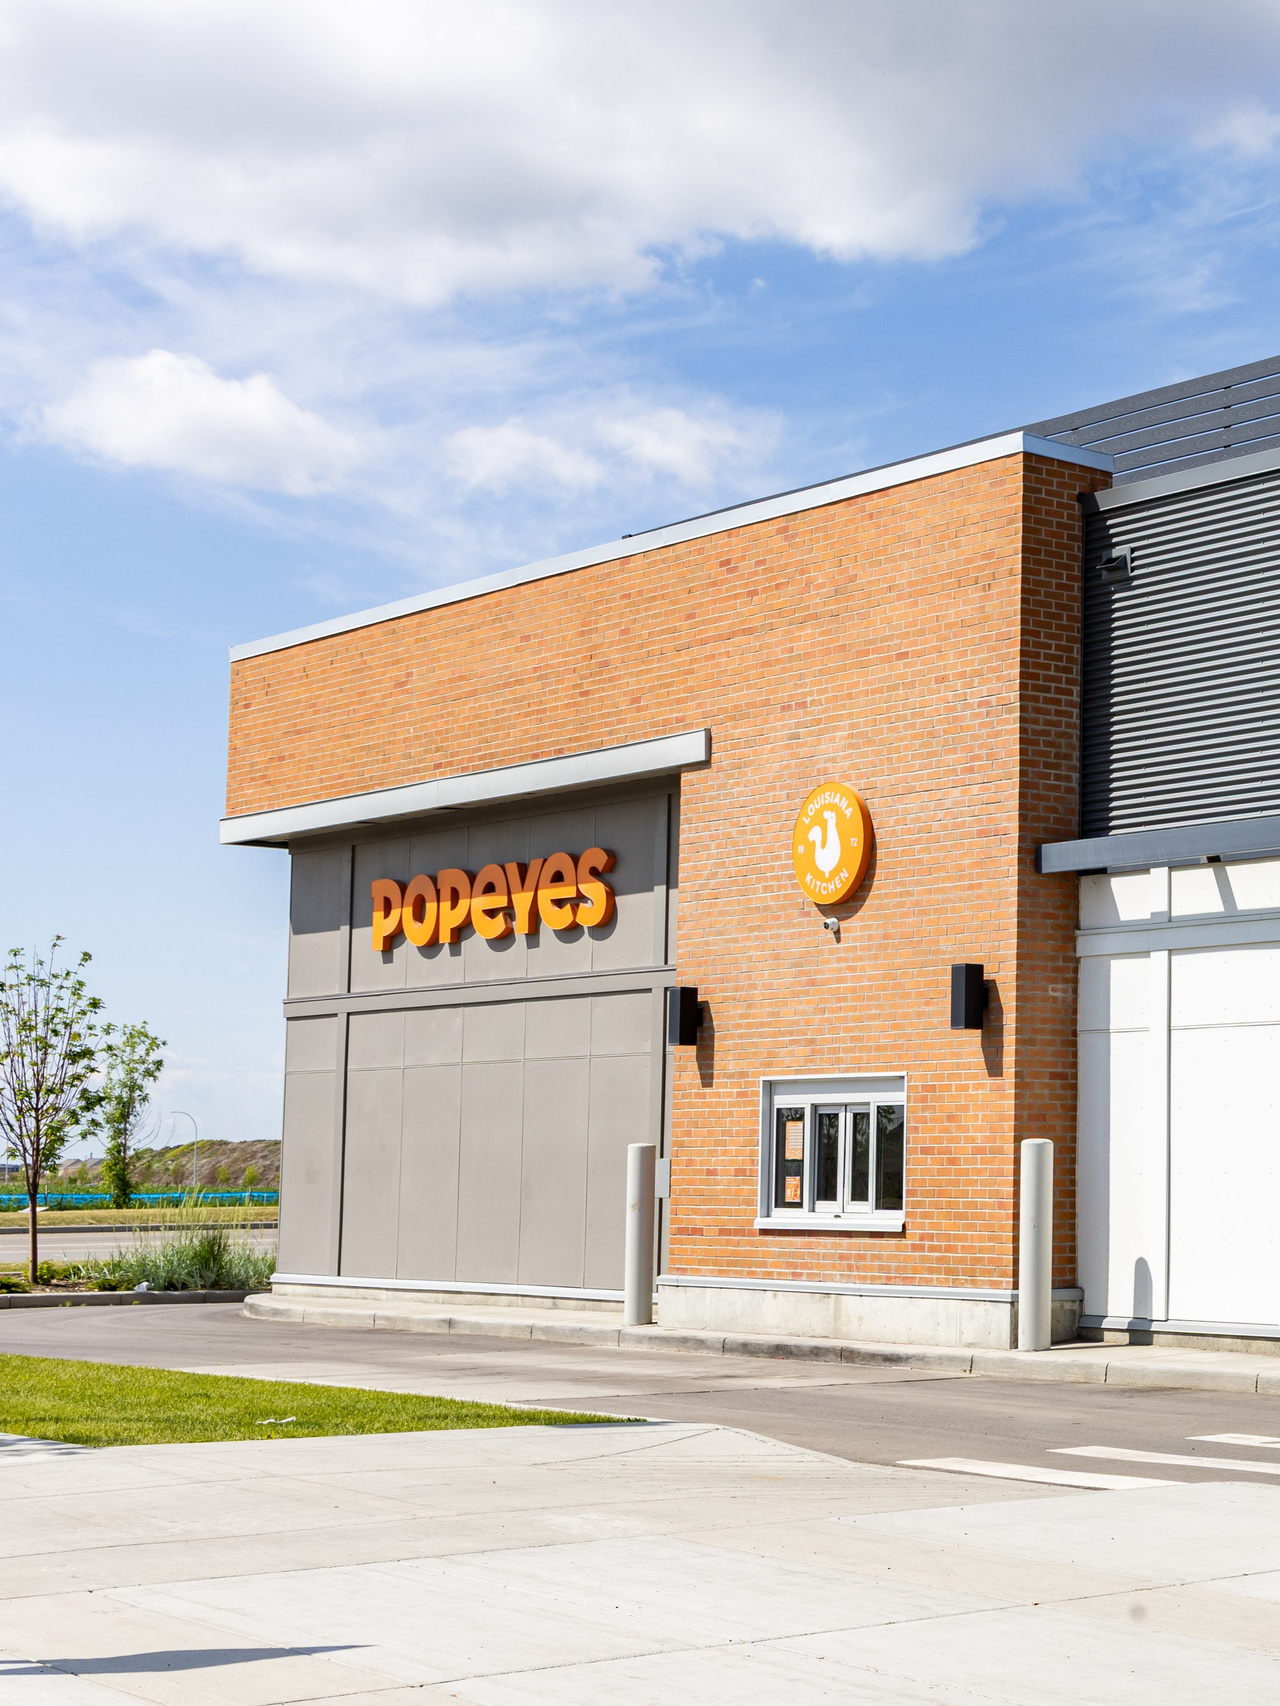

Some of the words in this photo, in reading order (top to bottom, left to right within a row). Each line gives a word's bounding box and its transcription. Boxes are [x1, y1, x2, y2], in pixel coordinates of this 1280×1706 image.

[802, 791, 853, 825] LOUISIANA
[797, 845, 805, 854] 19
[849, 837, 858, 847] 72
[805, 868, 849, 895] KITCHEN
